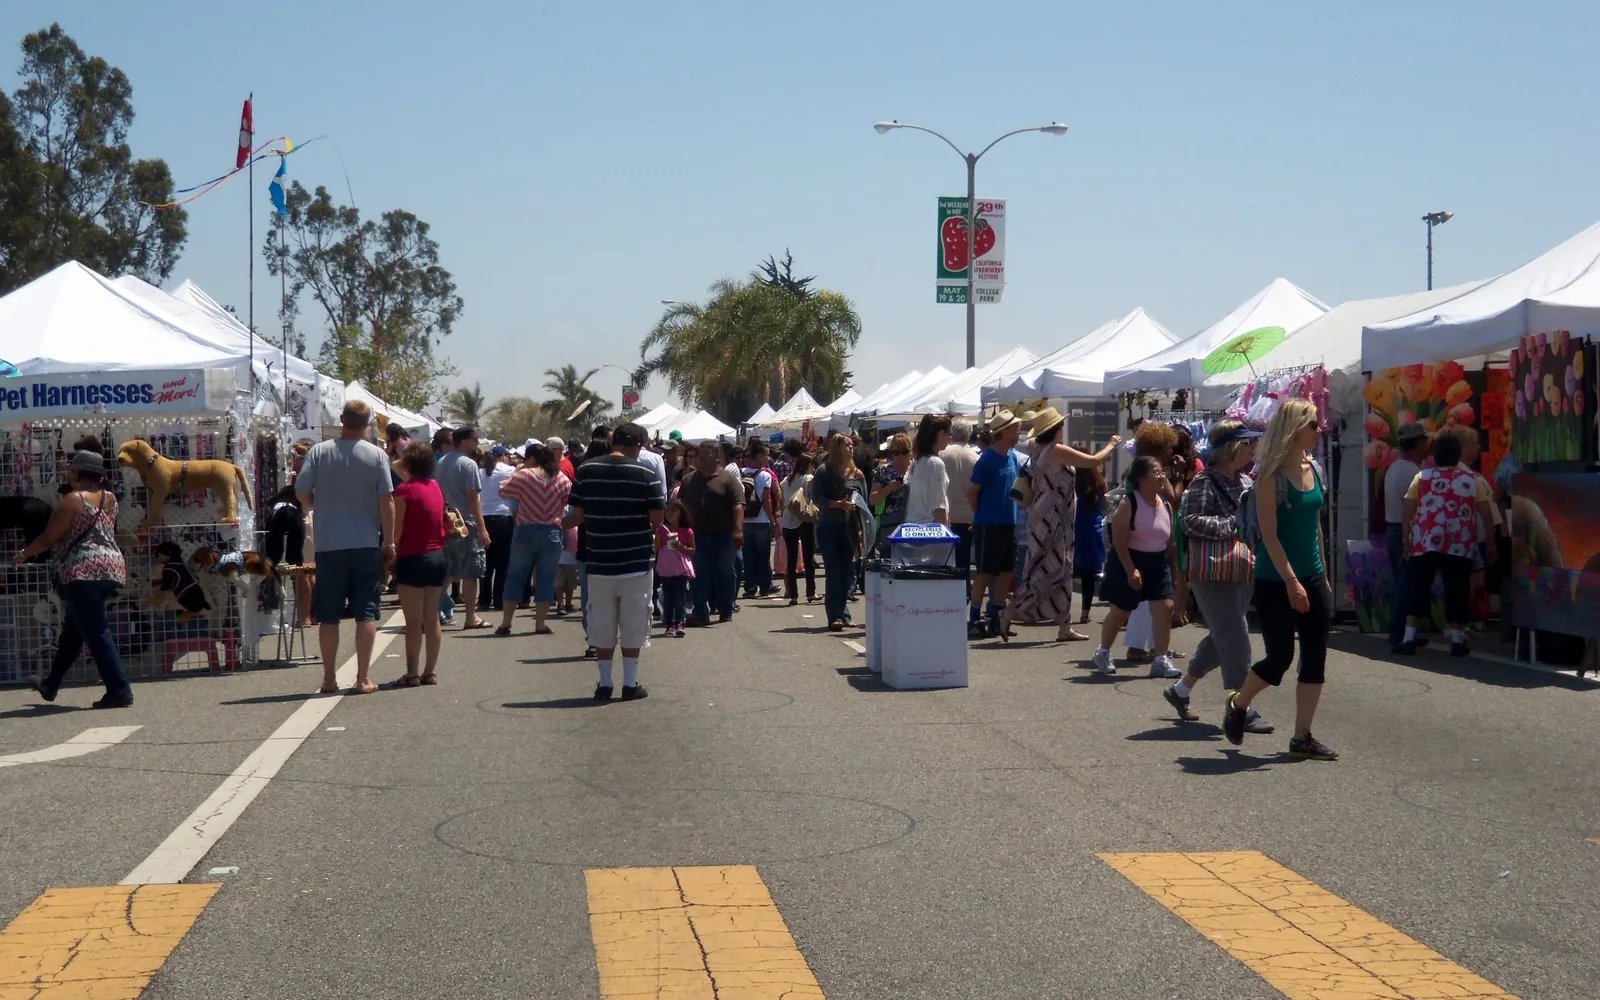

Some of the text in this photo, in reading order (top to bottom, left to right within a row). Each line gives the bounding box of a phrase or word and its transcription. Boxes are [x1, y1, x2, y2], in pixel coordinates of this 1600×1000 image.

[977, 202, 1003, 213] 29th
[939, 294, 966, 302] 19 & 20
[976, 288, 1000, 296] COLLEGE
[163, 376, 187, 389] and
[0, 383, 154, 411] Pet Harnesses
[151, 383, 200, 405] More!
